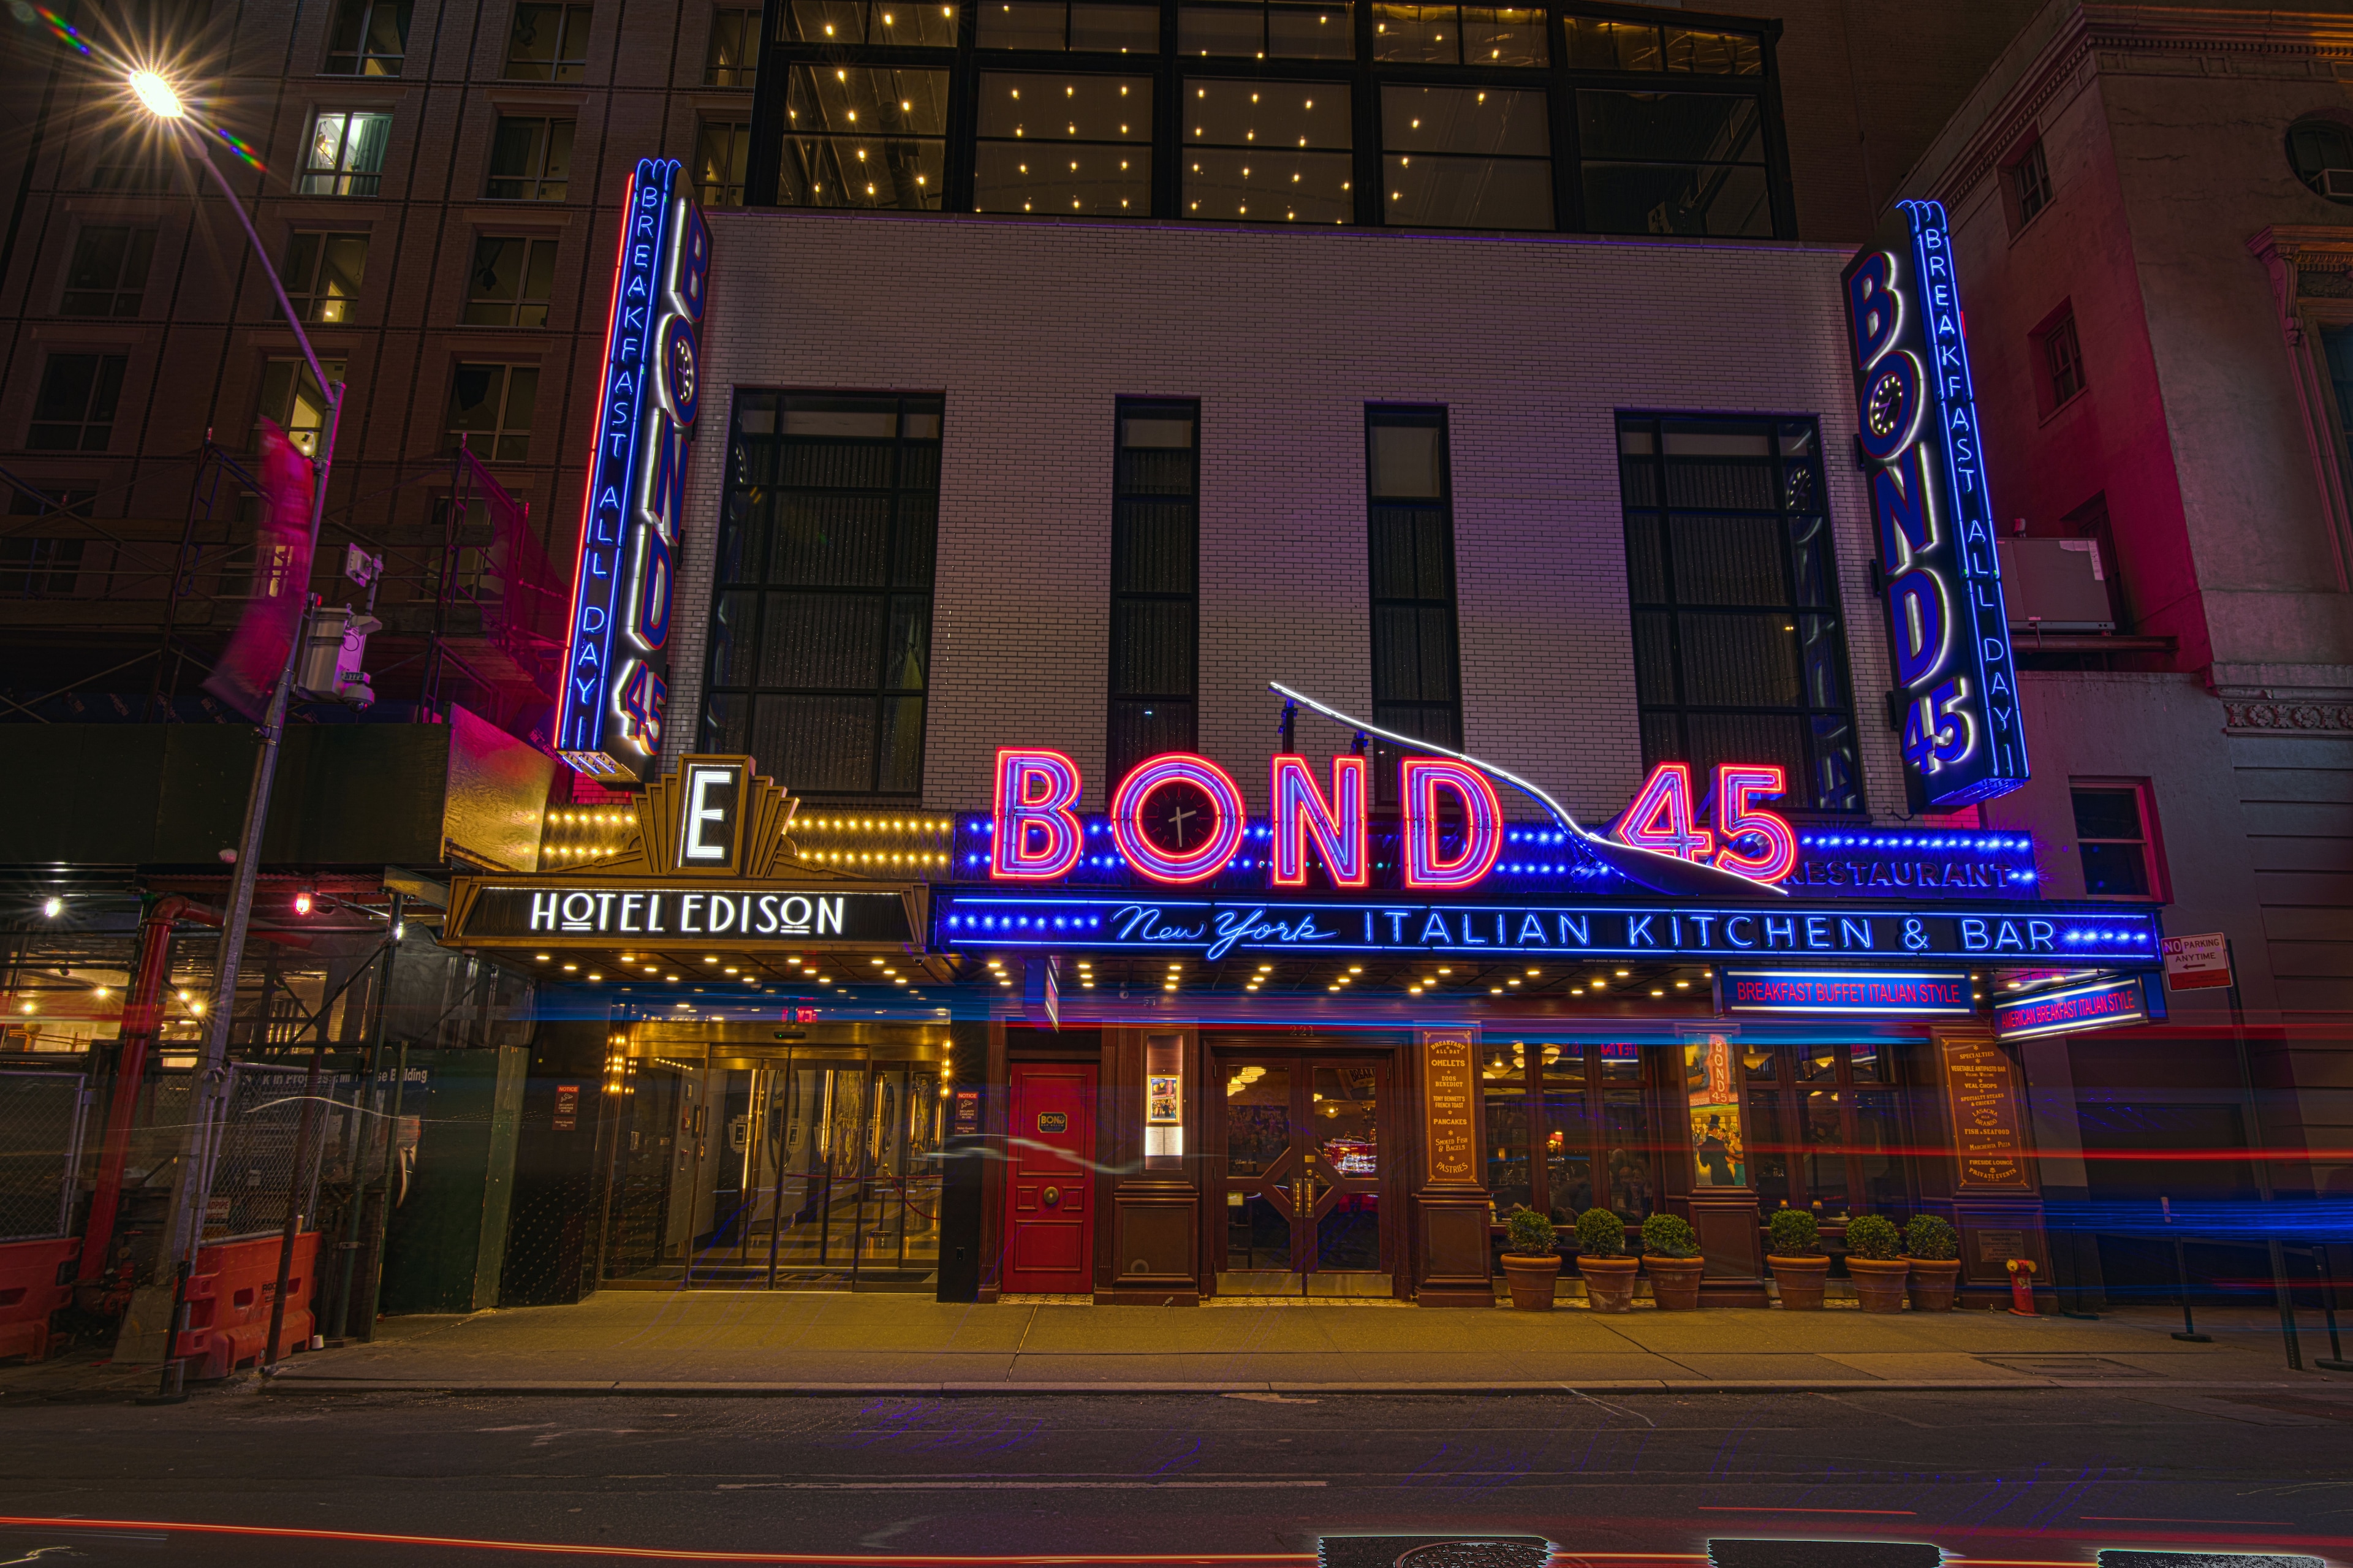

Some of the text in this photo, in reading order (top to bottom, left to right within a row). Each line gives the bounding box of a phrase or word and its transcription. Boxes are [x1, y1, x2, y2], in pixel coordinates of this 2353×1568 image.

[576, 186, 657, 705] BREAKFAST ALL DAY
[619, 197, 709, 756] BOND 45
[1926, 229, 2011, 731] BREAKFAST ALL DAY
[1849, 251, 1971, 775] BOND 45
[687, 770, 732, 858] E
[990, 747, 1797, 888] BOND 45
[1783, 861, 2011, 888] RESTAURANT
[531, 892, 844, 934] HOTEL EDISON
[1110, 905, 2056, 961] New York ITALIAN KITCHEN & BAR
[2164, 939, 2219, 953] NO PARKING
[2175, 952, 2216, 962] ANYTIME
[1737, 982, 1961, 1003] BREAKFAST BUFFET ITALIAN STYLE
[2001, 991, 2135, 1029] AMERICAN BREAKFAST ITALIAN STYLE
[1289, 1025, 1314, 1036] 221
[1430, 1040, 1466, 1051] BREAKFAST
[390, 1067, 428, 1084] Bilding
[1349, 1069, 1374, 1082] BREAK
[1712, 1040, 1727, 1102] BOND 45
[1972, 1108, 1998, 1117] LASAGNA
[1974, 1118, 1998, 1127] BRANDO
[1436, 1161, 1468, 1174] PASTRIES
[1968, 1167, 2017, 1179] PRIVATE EVENTS
